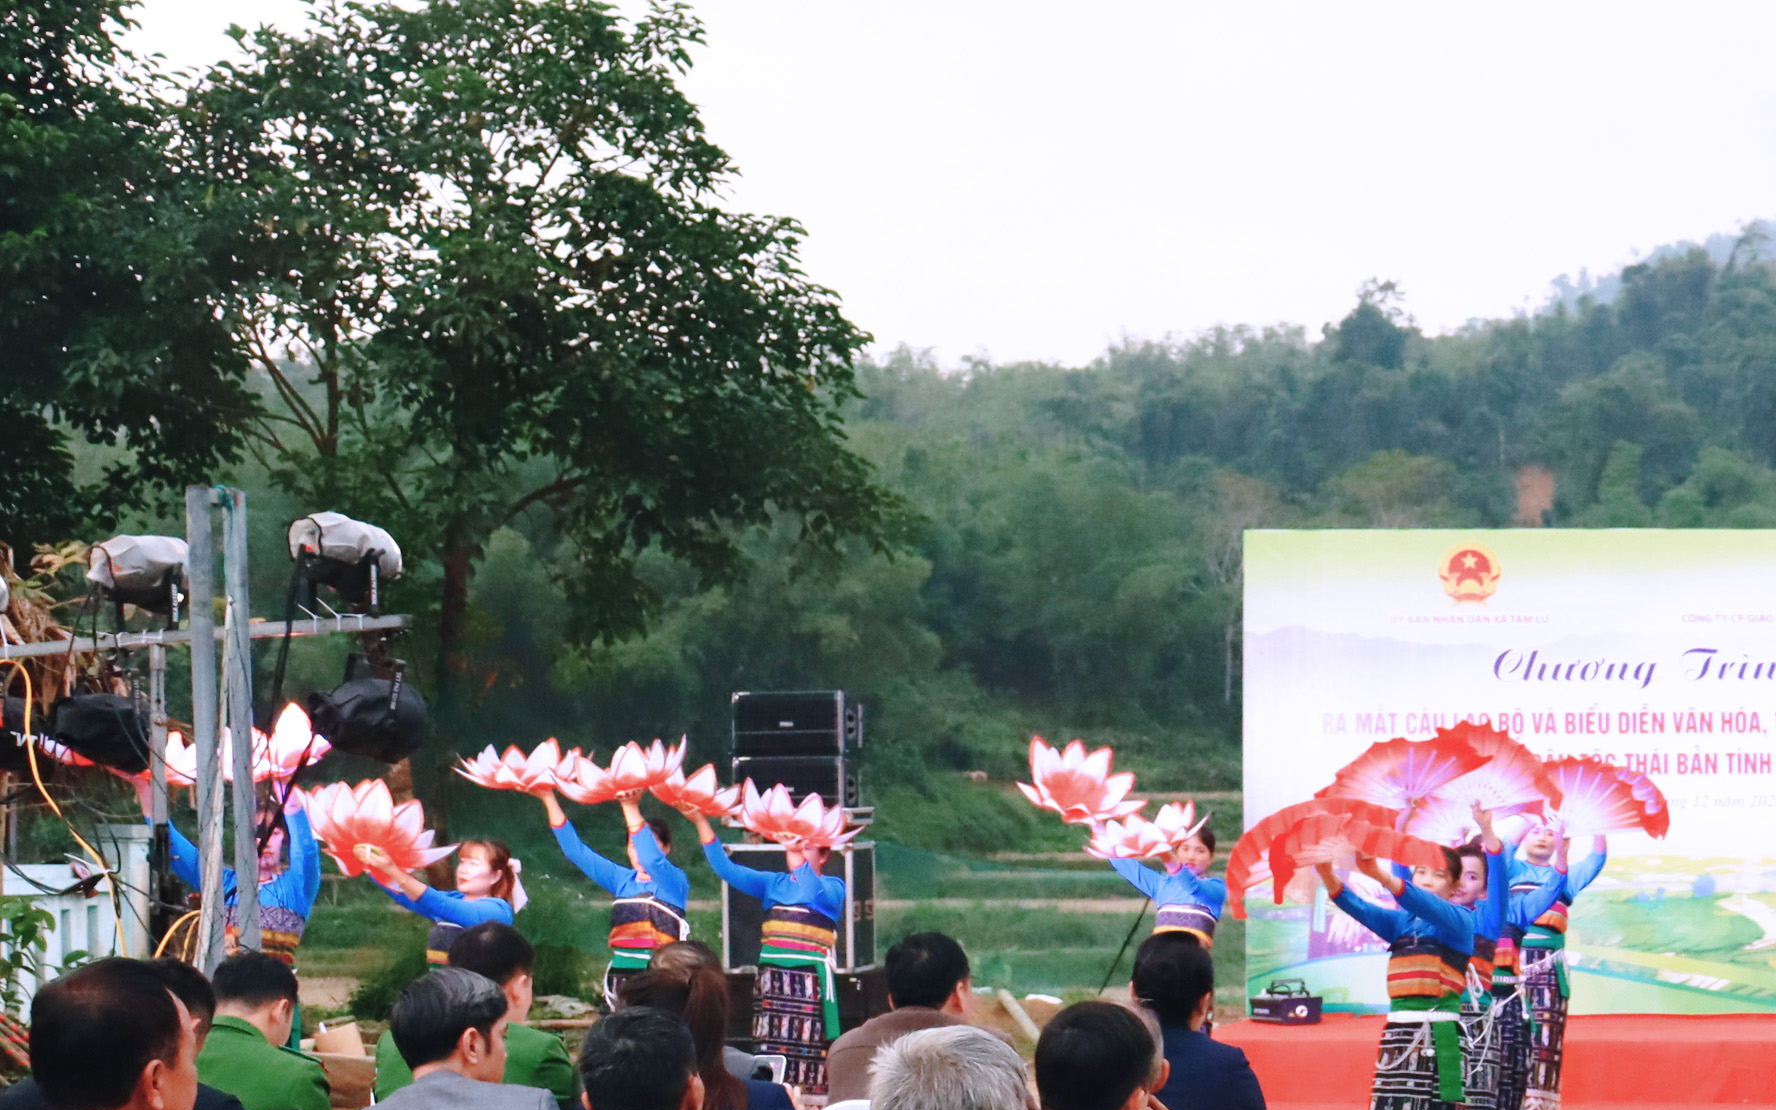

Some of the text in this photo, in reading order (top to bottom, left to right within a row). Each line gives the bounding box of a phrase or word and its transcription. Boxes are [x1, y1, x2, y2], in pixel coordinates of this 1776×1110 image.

[1493, 648, 1656, 689] Chương
[1322, 713, 1347, 734] RA
[1532, 707, 1557, 734] VÀ
[1564, 702, 1610, 734] BIỂU
[1618, 703, 1665, 734] DIỄN
[1673, 707, 1713, 734] VĂN
